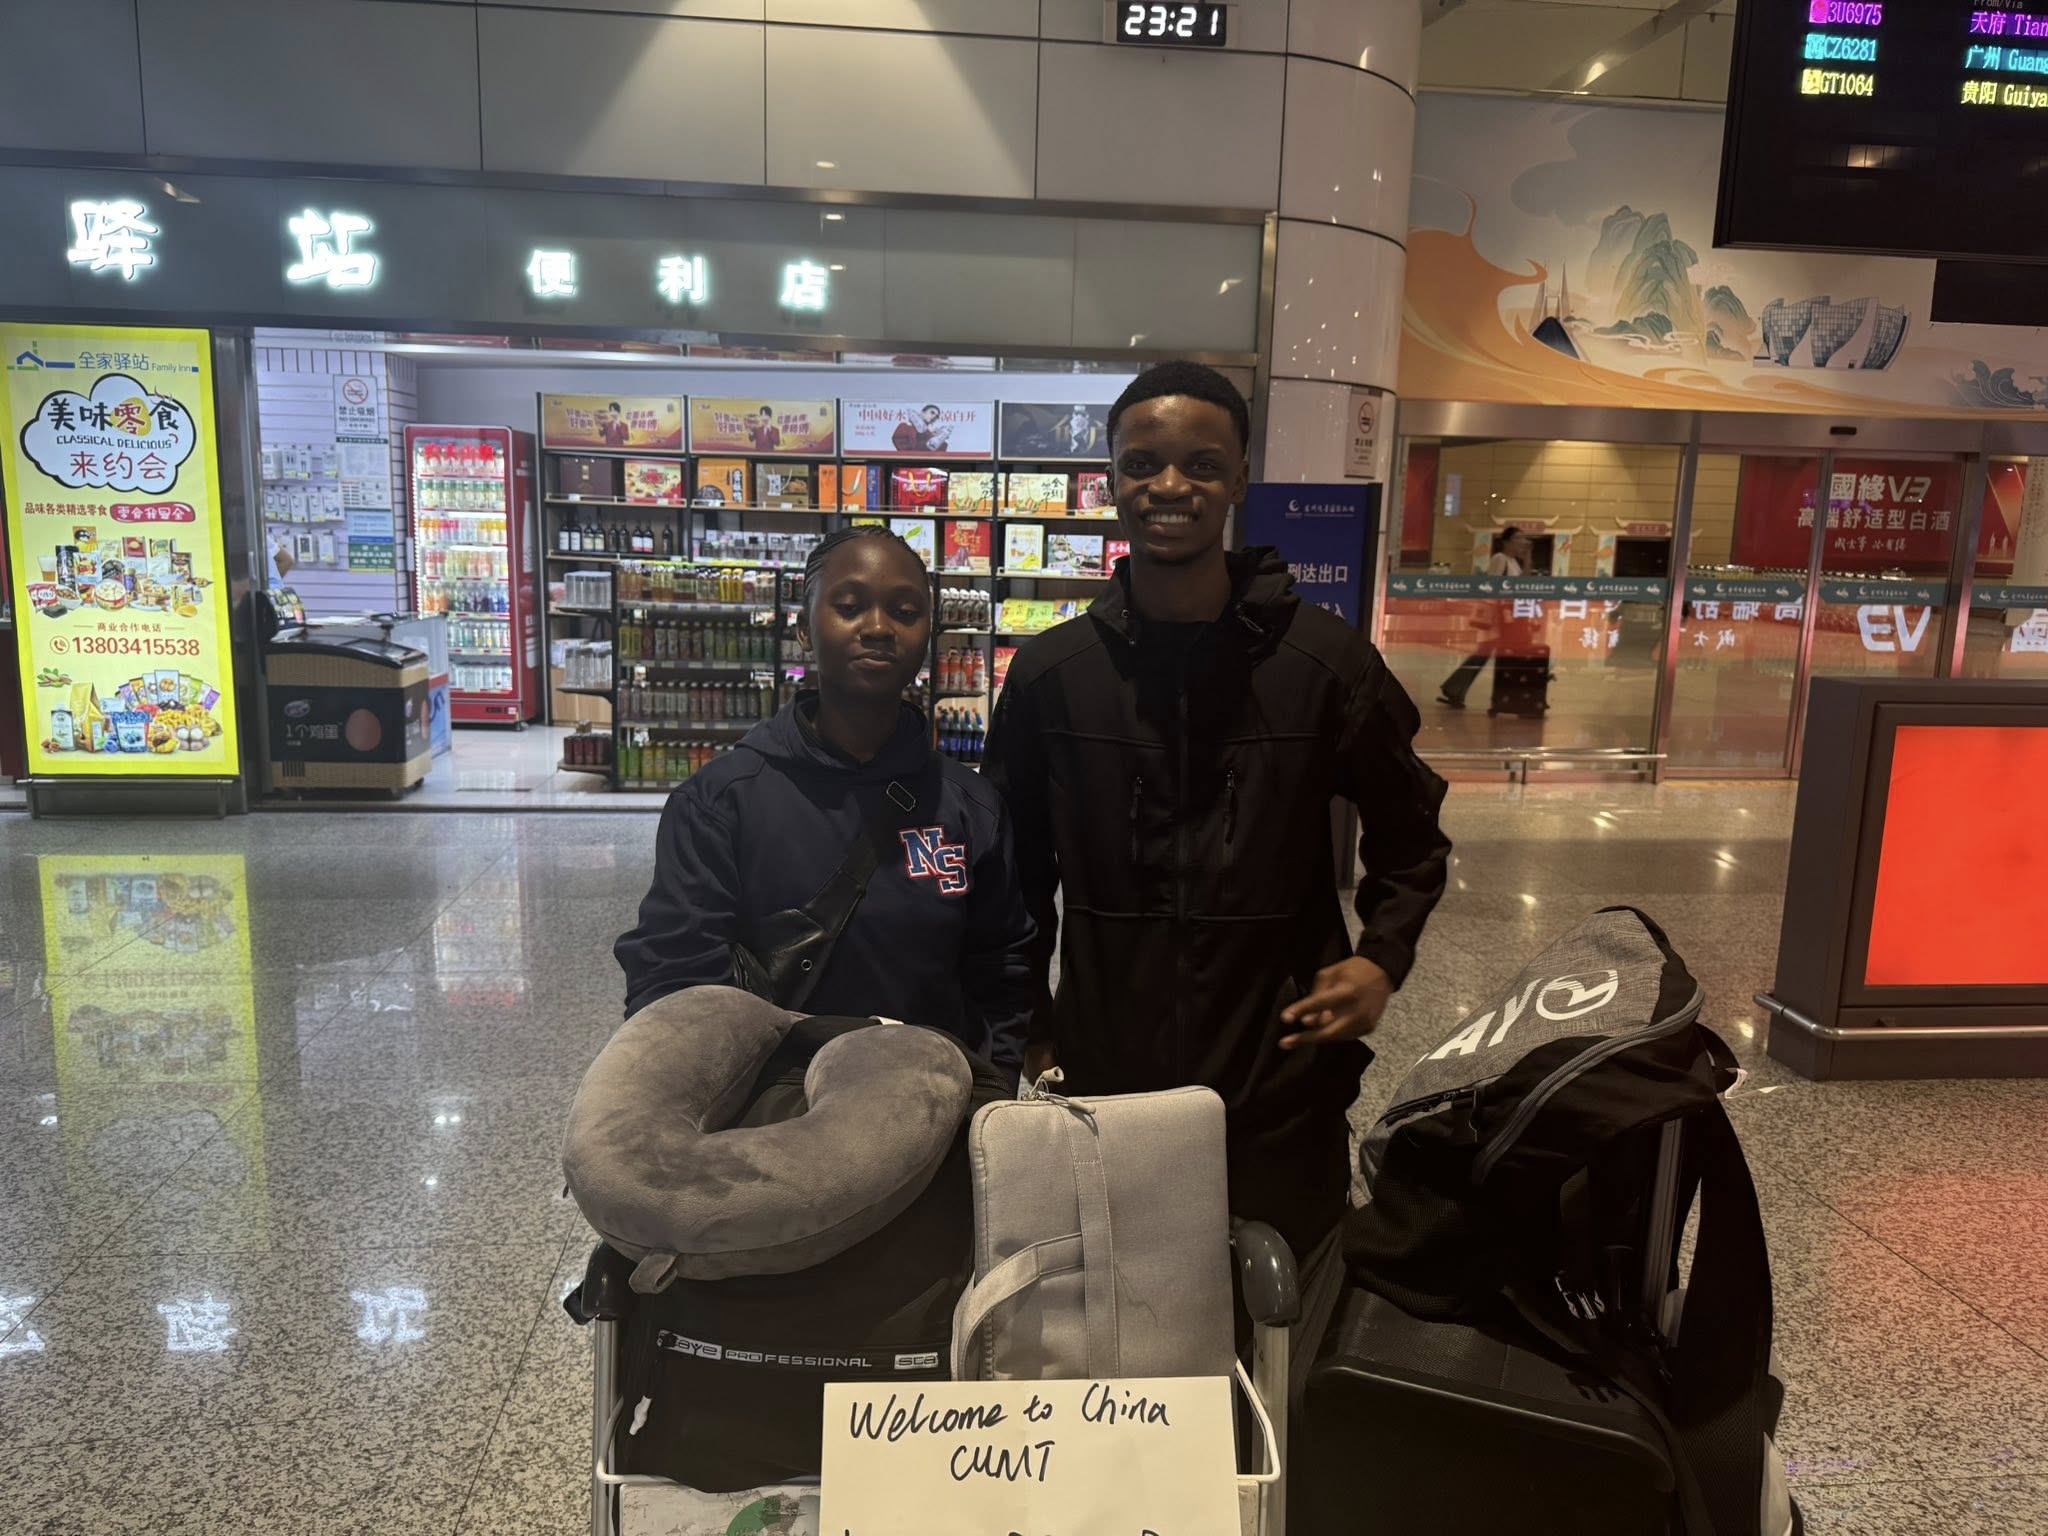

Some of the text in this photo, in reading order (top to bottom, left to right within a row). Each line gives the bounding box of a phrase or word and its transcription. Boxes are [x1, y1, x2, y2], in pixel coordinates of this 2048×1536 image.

[1125, 5, 1218, 37] 23:21
[1827, 2, 1882, 25] 3U6975
[1970, 11, 2006, 36] 天府
[1823, 37, 1877, 61] CZ6281
[1965, 45, 2002, 71] 广州
[1820, 73, 1874, 96] GT1064
[1960, 80, 1998, 105] 贵阳
[79, 351, 191, 373] 全家驿站 Family Inn
[48, 397, 179, 435] 美味零食
[56, 435, 172, 449] CLASSICAL DELICIOUS
[70, 450, 168, 480] 来约会
[72, 637, 200, 656] 13803415538
[725, 1349, 872, 1367] PROFESSIONAL
[849, 1383, 1170, 1441] Welcome to China
[950, 1440, 1055, 1481] CUMT
